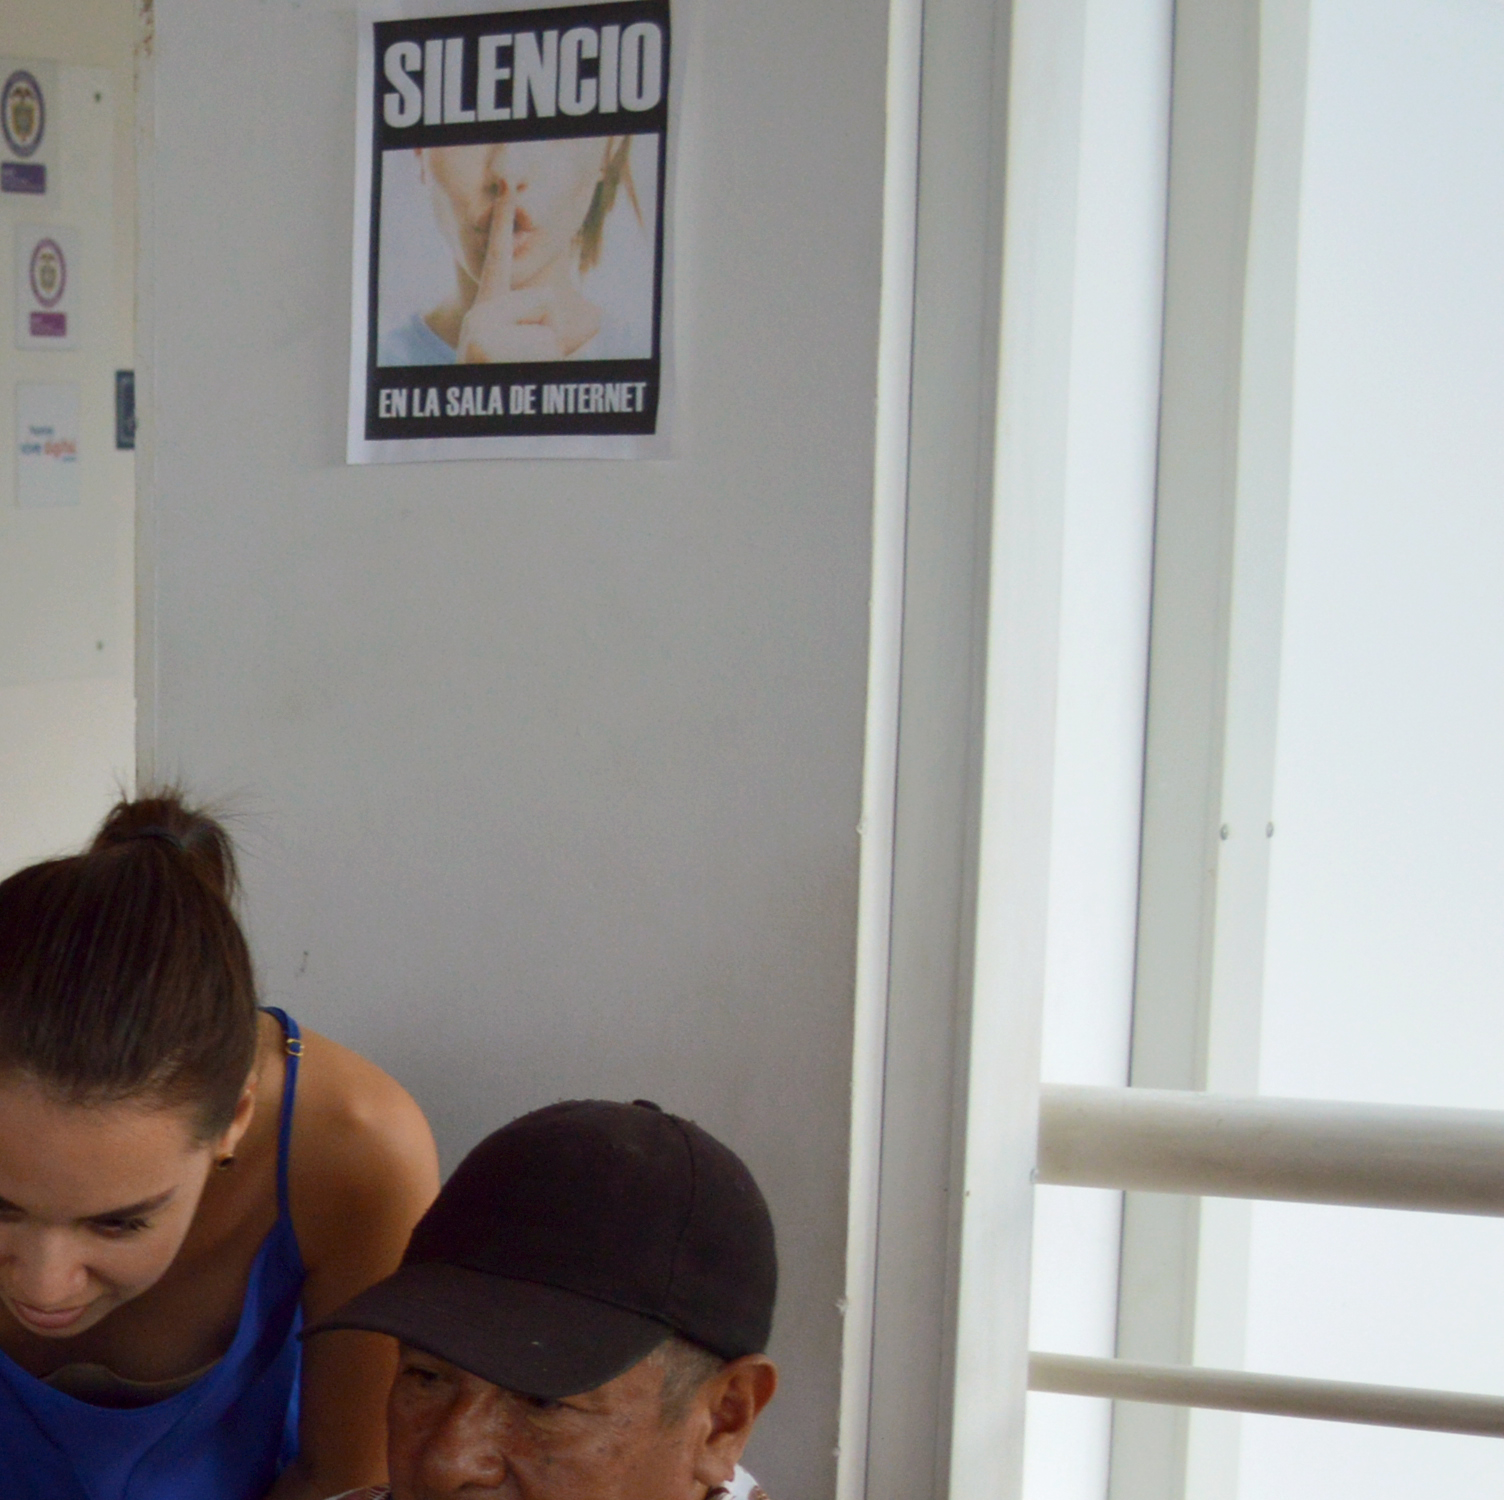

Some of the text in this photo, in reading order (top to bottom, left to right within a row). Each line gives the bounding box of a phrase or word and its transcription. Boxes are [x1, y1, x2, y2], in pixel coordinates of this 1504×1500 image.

[383, 22, 663, 128] SILENCIO
[378, 382, 647, 418] EN LA SALA DE INTERNET
